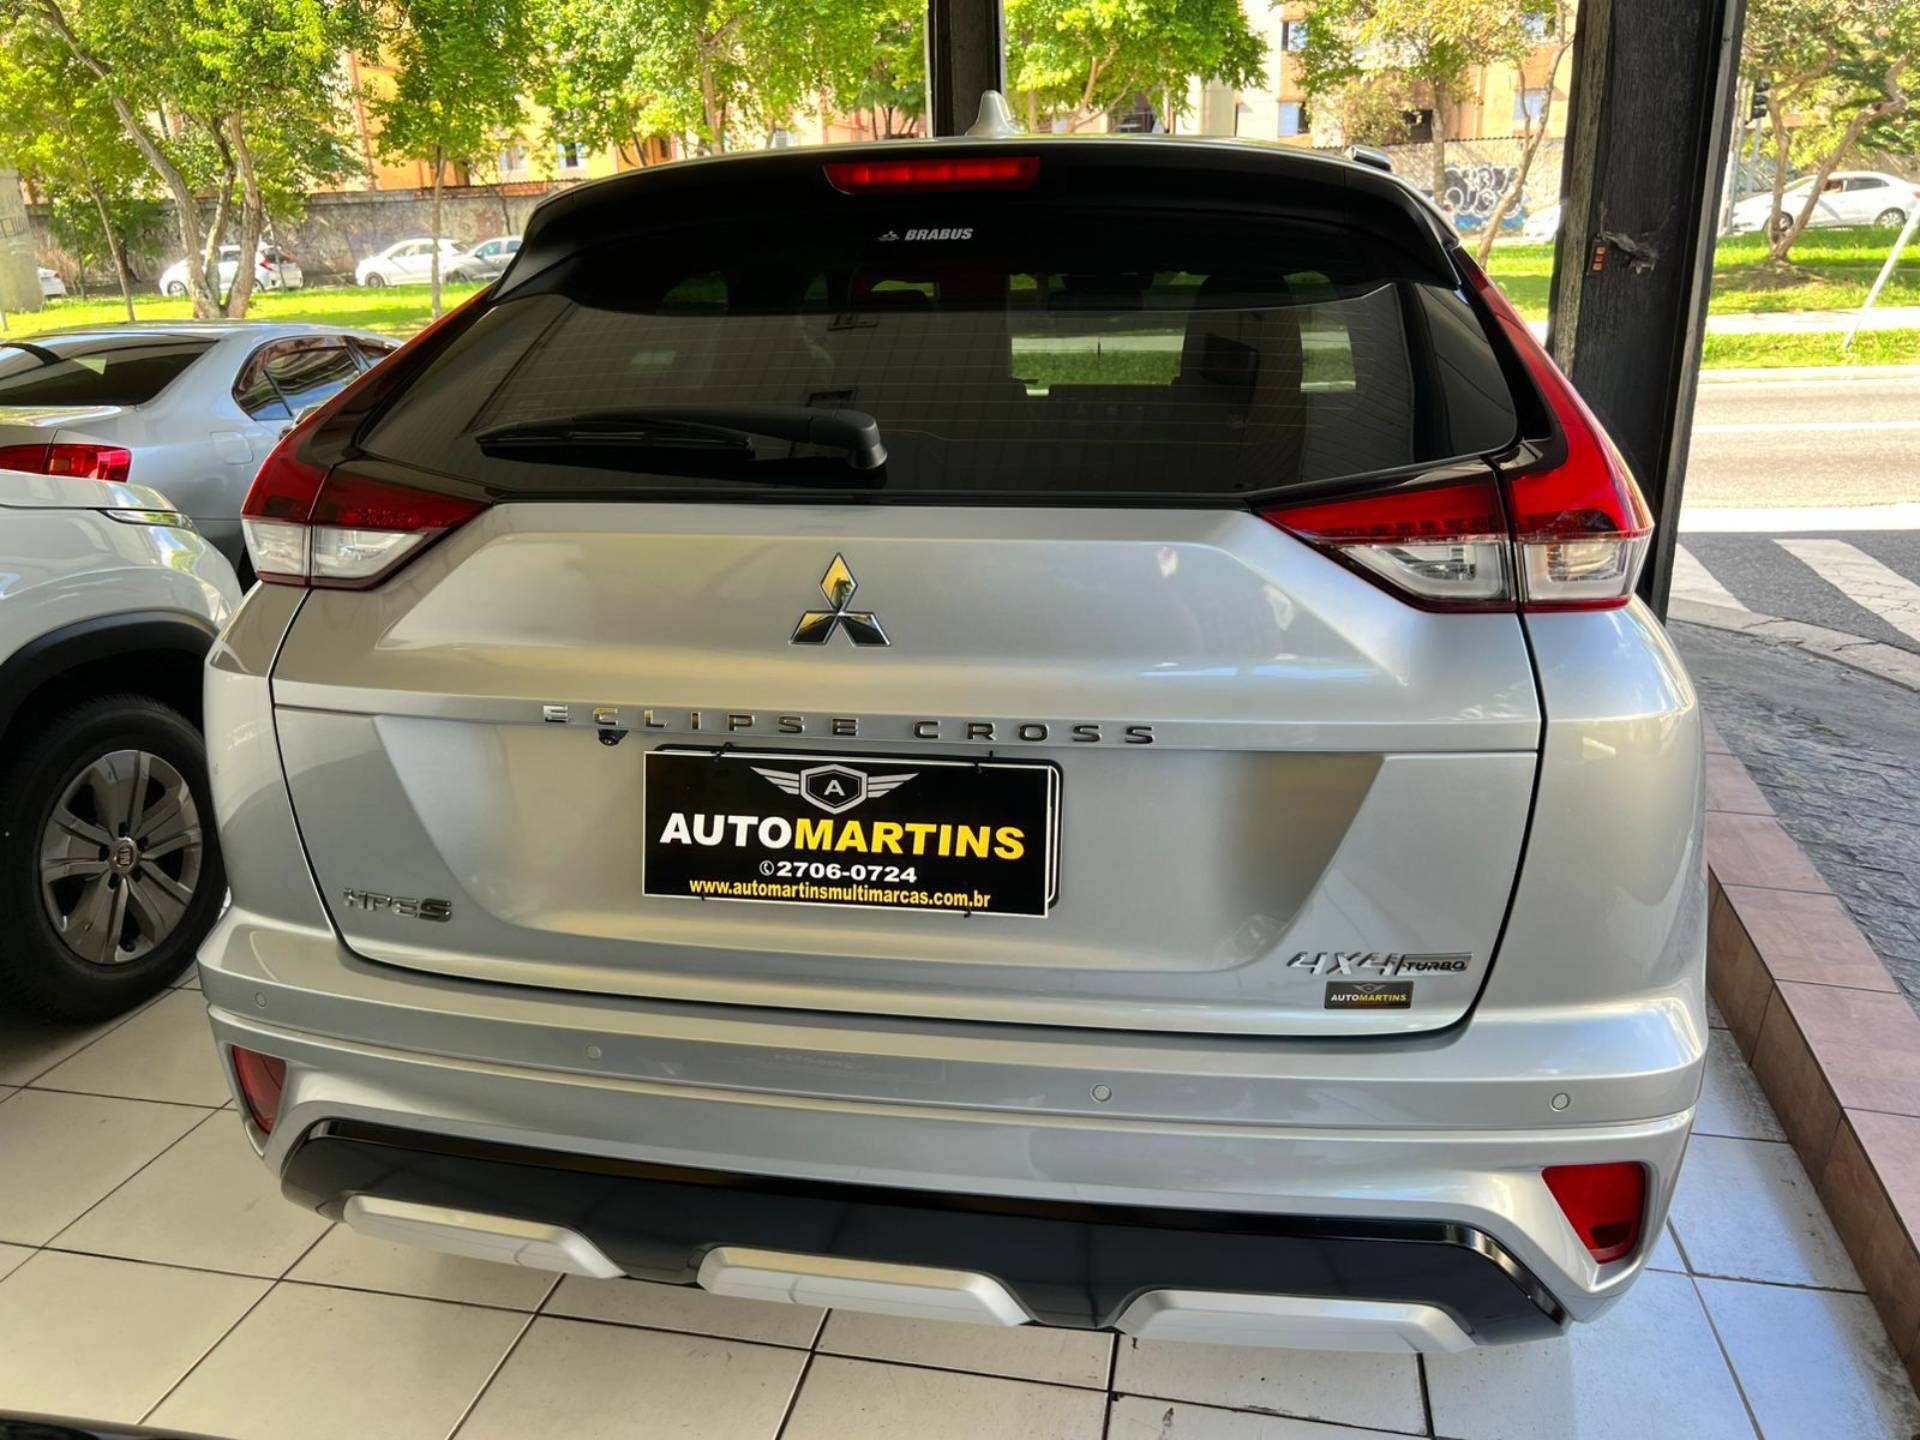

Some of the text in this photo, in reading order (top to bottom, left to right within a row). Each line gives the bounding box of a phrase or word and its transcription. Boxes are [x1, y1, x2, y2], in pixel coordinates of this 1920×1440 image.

[904, 228, 974, 240] BRABUS
[543, 705, 1155, 745] ECLIPSE CROSS
[659, 811, 1026, 861] AUTOMARTINS
[776, 860, 918, 883] 2706-0724
[689, 878, 992, 909] www.automartinsmultimarcas.com.br
[1330, 992, 1408, 1002] AUTOMARTINS
